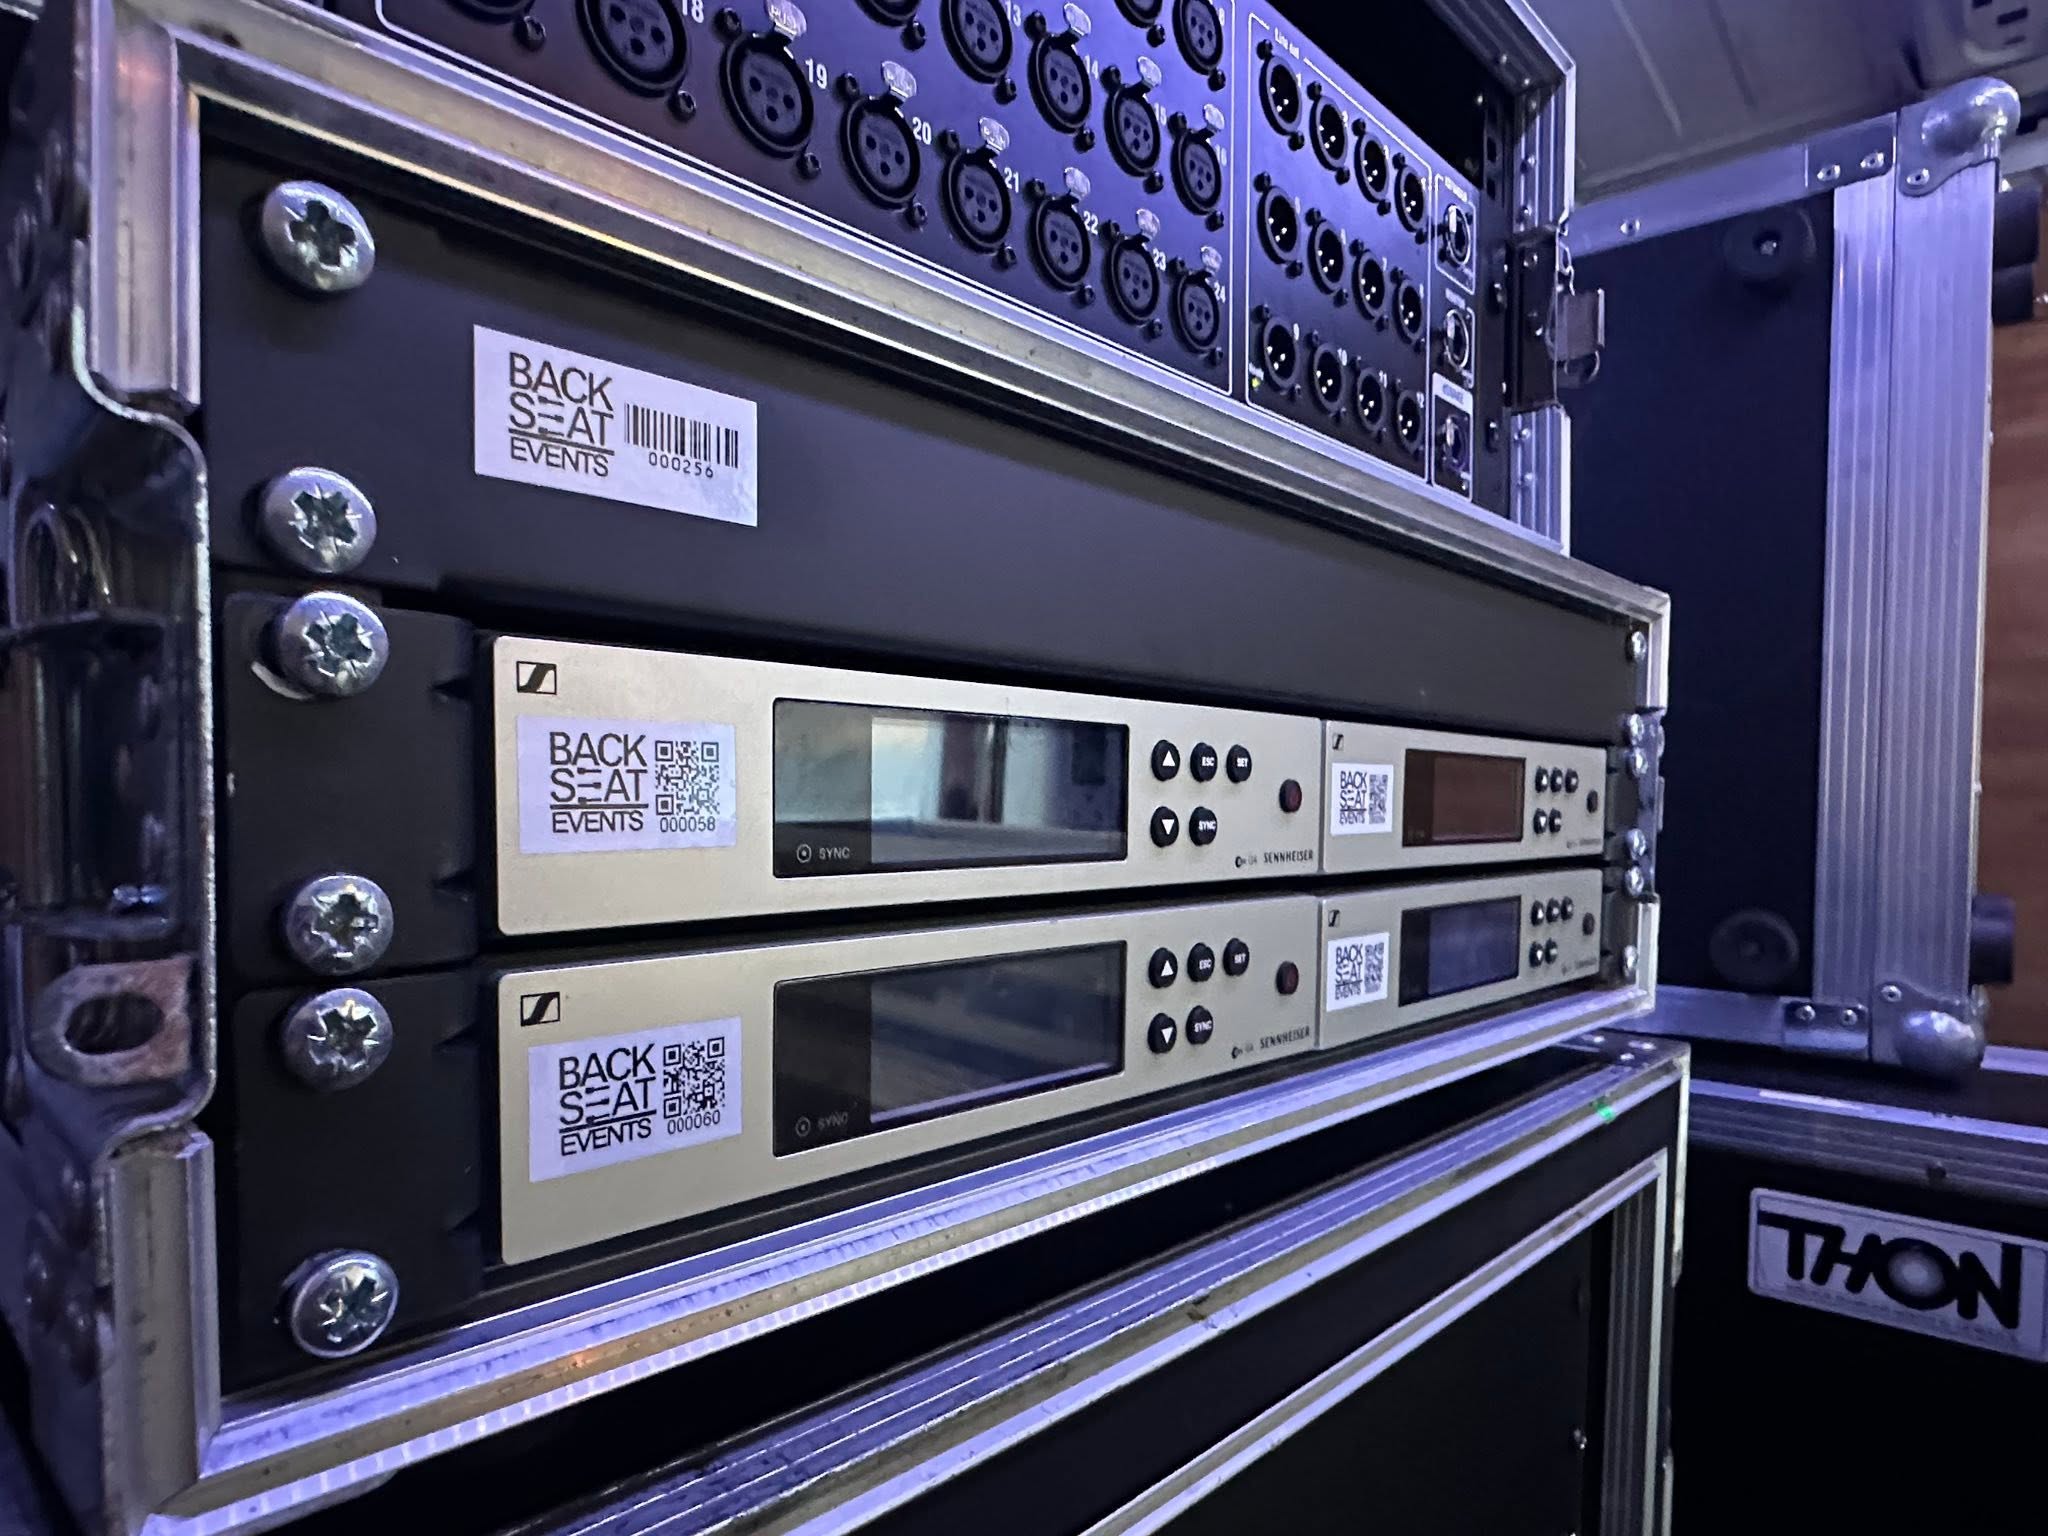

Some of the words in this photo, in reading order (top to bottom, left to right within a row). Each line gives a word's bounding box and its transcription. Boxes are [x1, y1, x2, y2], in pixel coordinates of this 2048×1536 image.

[682, 0, 704, 24] 18
[1005, 1, 1021, 27] 13
[805, 58, 828, 89] 19
[1085, 54, 1099, 80] 14
[912, 117, 932, 145] 20
[1003, 167, 1020, 193] 21
[1083, 210, 1099, 236] 22
[1152, 247, 1167, 272] 23
[1214, 281, 1227, 304] 24
[509, 352, 614, 411] BACK
[508, 391, 614, 447] SEAT
[510, 437, 609, 477] EVENTS
[648, 451, 714, 479] 000256
[549, 731, 648, 767] BACK
[550, 767, 648, 804] SEAT
[1339, 771, 1367, 789] BACK
[1339, 789, 1366, 809] SEAT
[552, 810, 644, 834] EVENTS
[659, 816, 716, 833] 000058
[819, 847, 851, 860] SYNC
[1263, 849, 1314, 864] SENNHEISER
[1335, 943, 1363, 965] BACK
[1259, 1025, 1310, 1049] SENNHEISER
[558, 1043, 656, 1090] BACK
[559, 1076, 656, 1125] SEAT
[667, 1109, 720, 1135] 000060
[561, 1118, 651, 1156] EVENTS
[1757, 1210, 2022, 1330] THON
